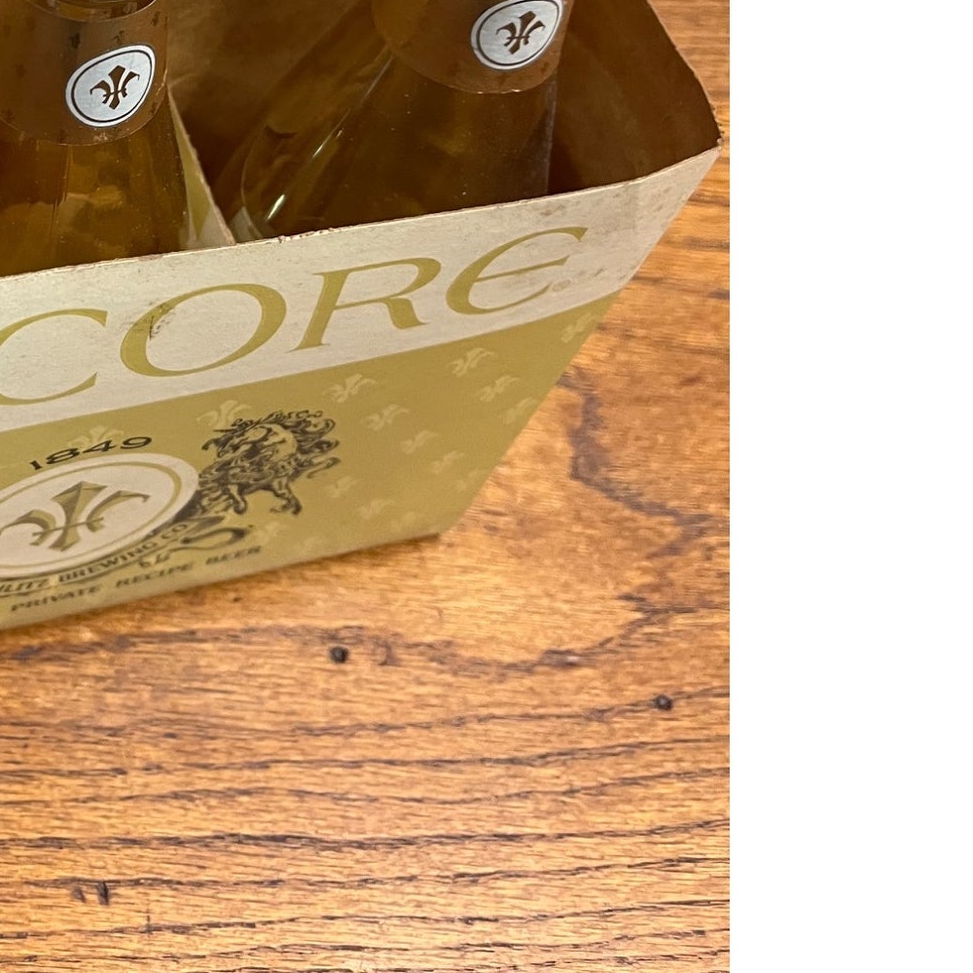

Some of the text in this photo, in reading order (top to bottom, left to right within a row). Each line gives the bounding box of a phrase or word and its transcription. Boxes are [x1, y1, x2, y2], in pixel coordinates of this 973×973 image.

[29, 436, 152, 471] 1849
[10, 583, 102, 612] PRIVATE
[115, 561, 195, 588] RECIPE
[204, 545, 262, 566] BEER
[58, 541, 158, 583] BREWING
